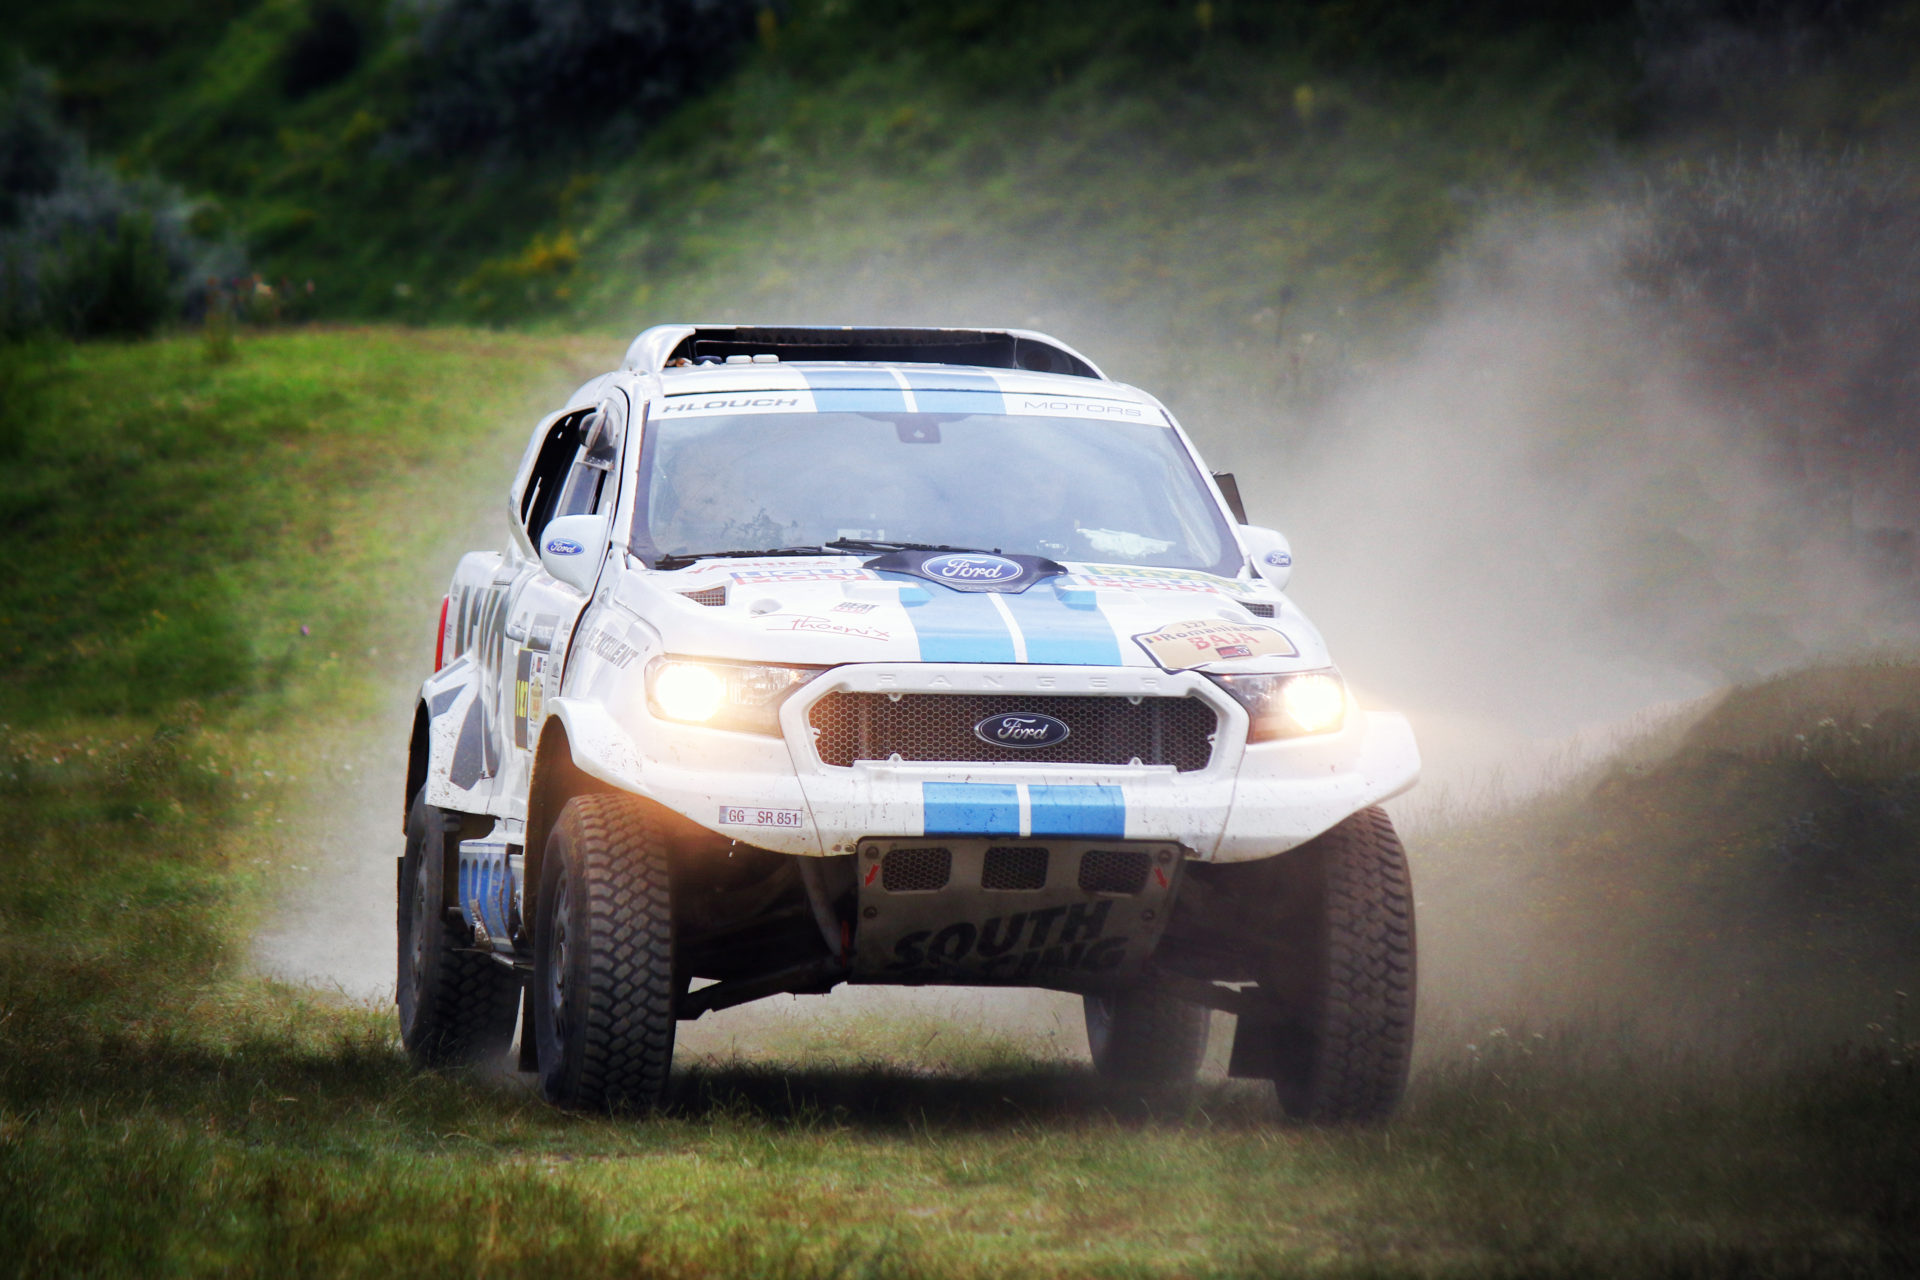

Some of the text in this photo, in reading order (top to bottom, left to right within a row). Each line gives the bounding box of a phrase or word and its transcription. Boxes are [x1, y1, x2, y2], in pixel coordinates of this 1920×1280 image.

[662, 398, 799, 413] HLOUCH
[1024, 401, 1142, 417] MOTORS
[550, 540, 577, 553] Ford
[942, 558, 1002, 579] Ford
[791, 614, 890, 638] Phoenix
[1181, 620, 1207, 630] 127
[1187, 633, 1261, 651] BAJA
[877, 673, 1160, 691] RANGER
[997, 716, 1049, 741] Ford
[729, 809, 798, 825] GG SR 851
[885, 900, 1113, 969] SOUTH
